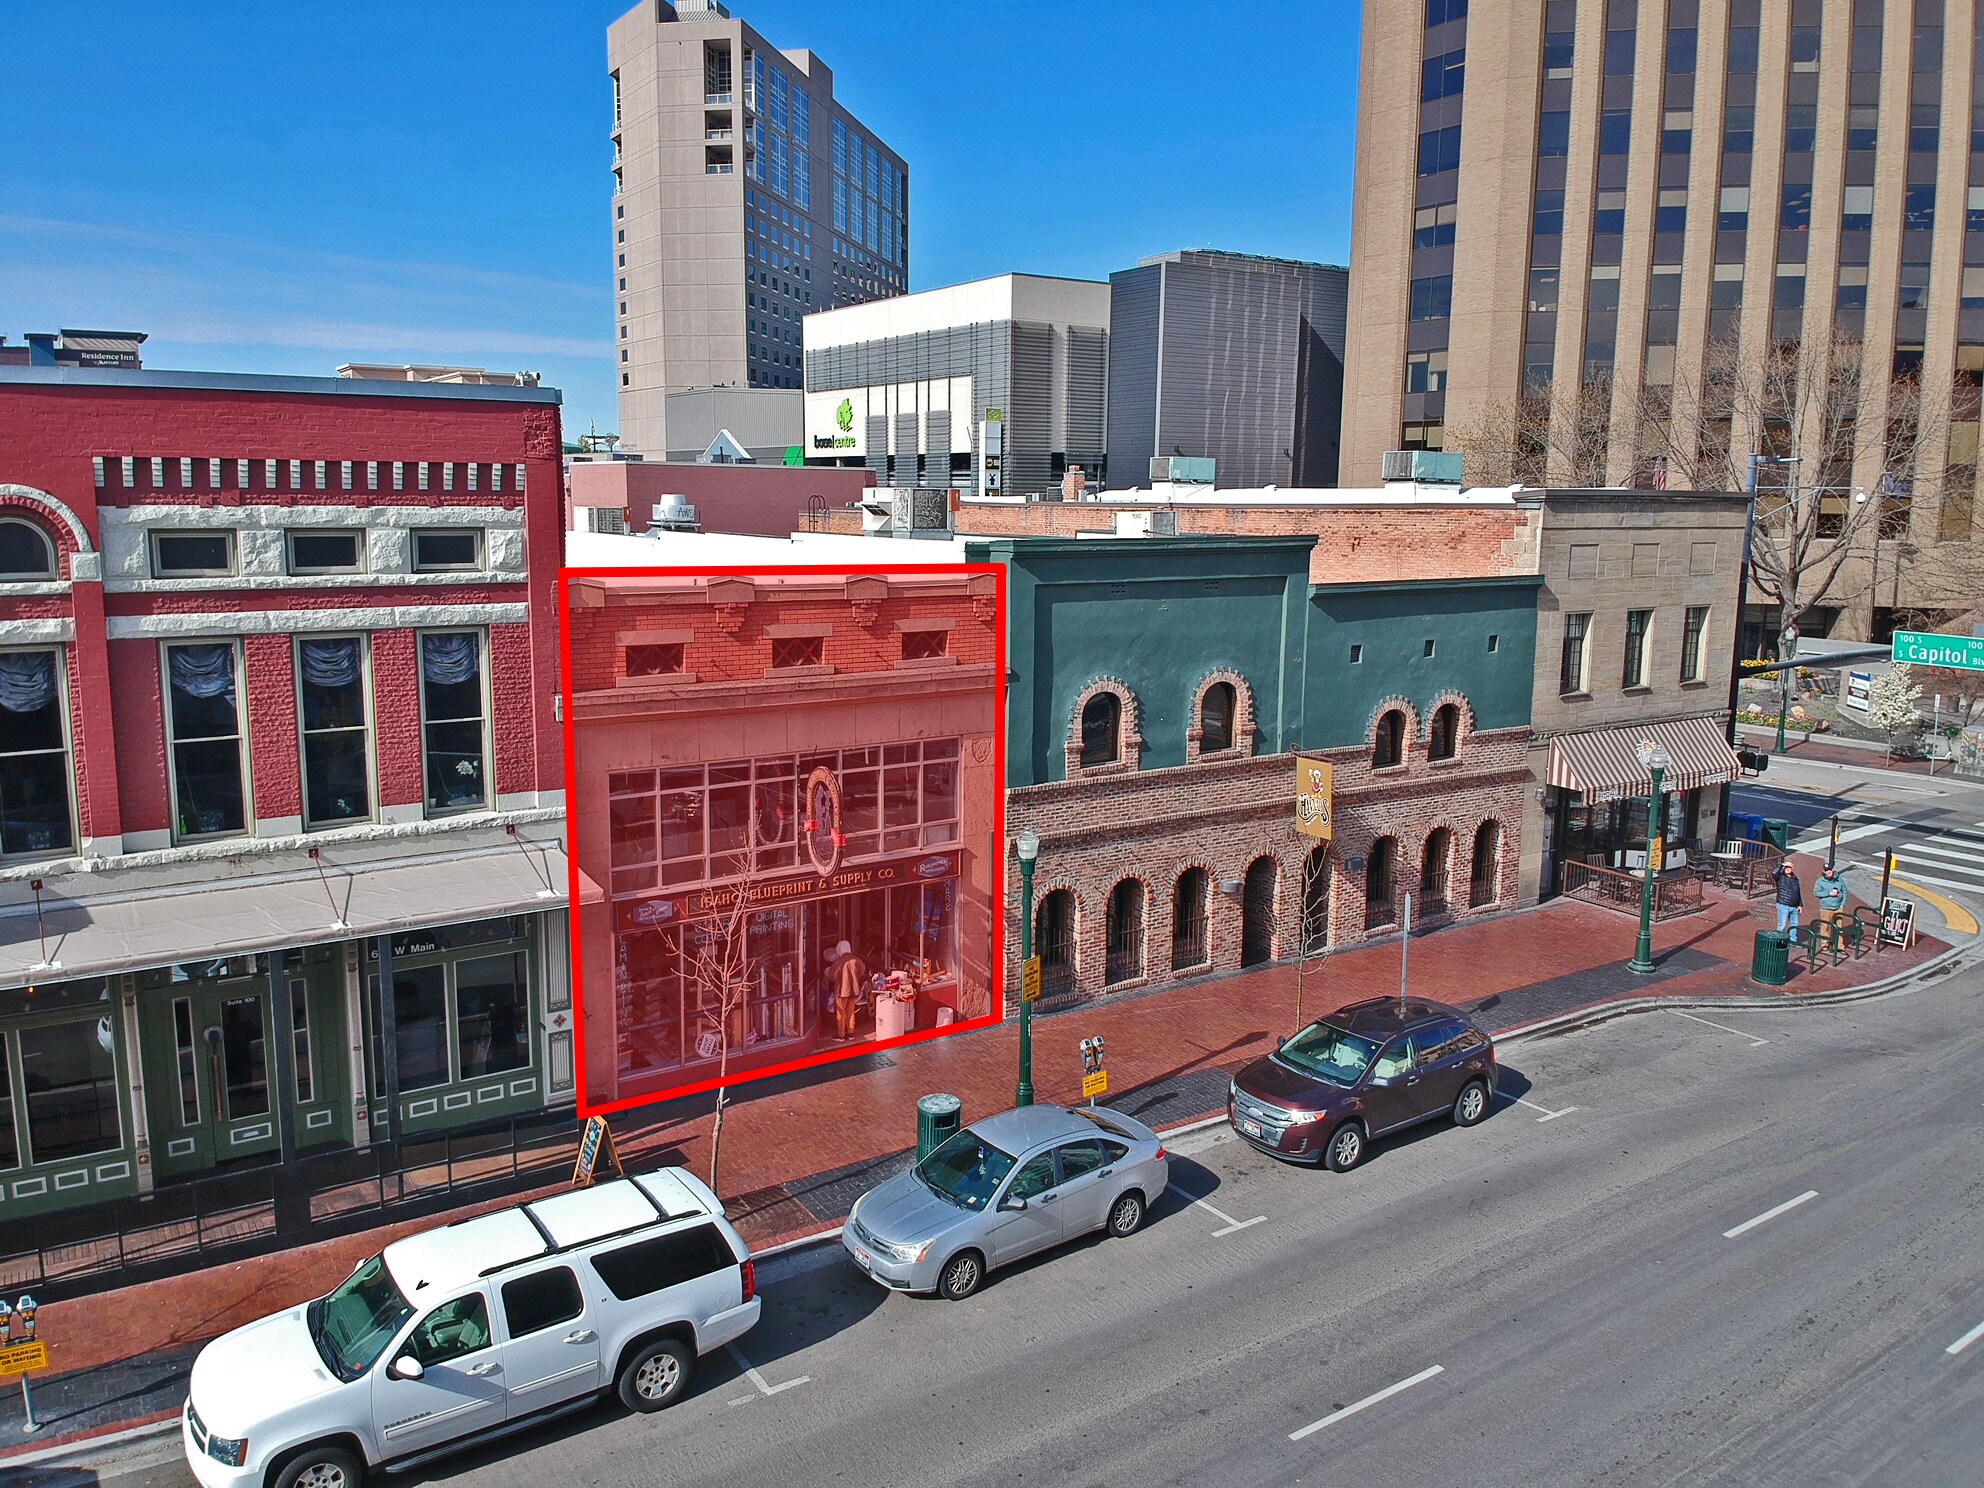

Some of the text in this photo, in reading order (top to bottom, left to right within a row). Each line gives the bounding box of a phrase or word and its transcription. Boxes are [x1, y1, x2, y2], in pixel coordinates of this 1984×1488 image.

[81, 352, 120, 360] Residence
[1900, 634, 1983, 650] 100 S 100
[1898, 649, 1904, 658] S
[1908, 644, 1968, 665] Capitol
[700, 868, 895, 909] IDAHO BLUEPRINT & SUPPLY CO.
[755, 909, 789, 922] DIGITAL
[749, 919, 794, 935] PRINTING
[394, 945, 406, 956] W
[410, 942, 435, 954] Main
[12, 1348, 41, 1357] PARKING
[13, 1354, 41, 1362] WAITING
